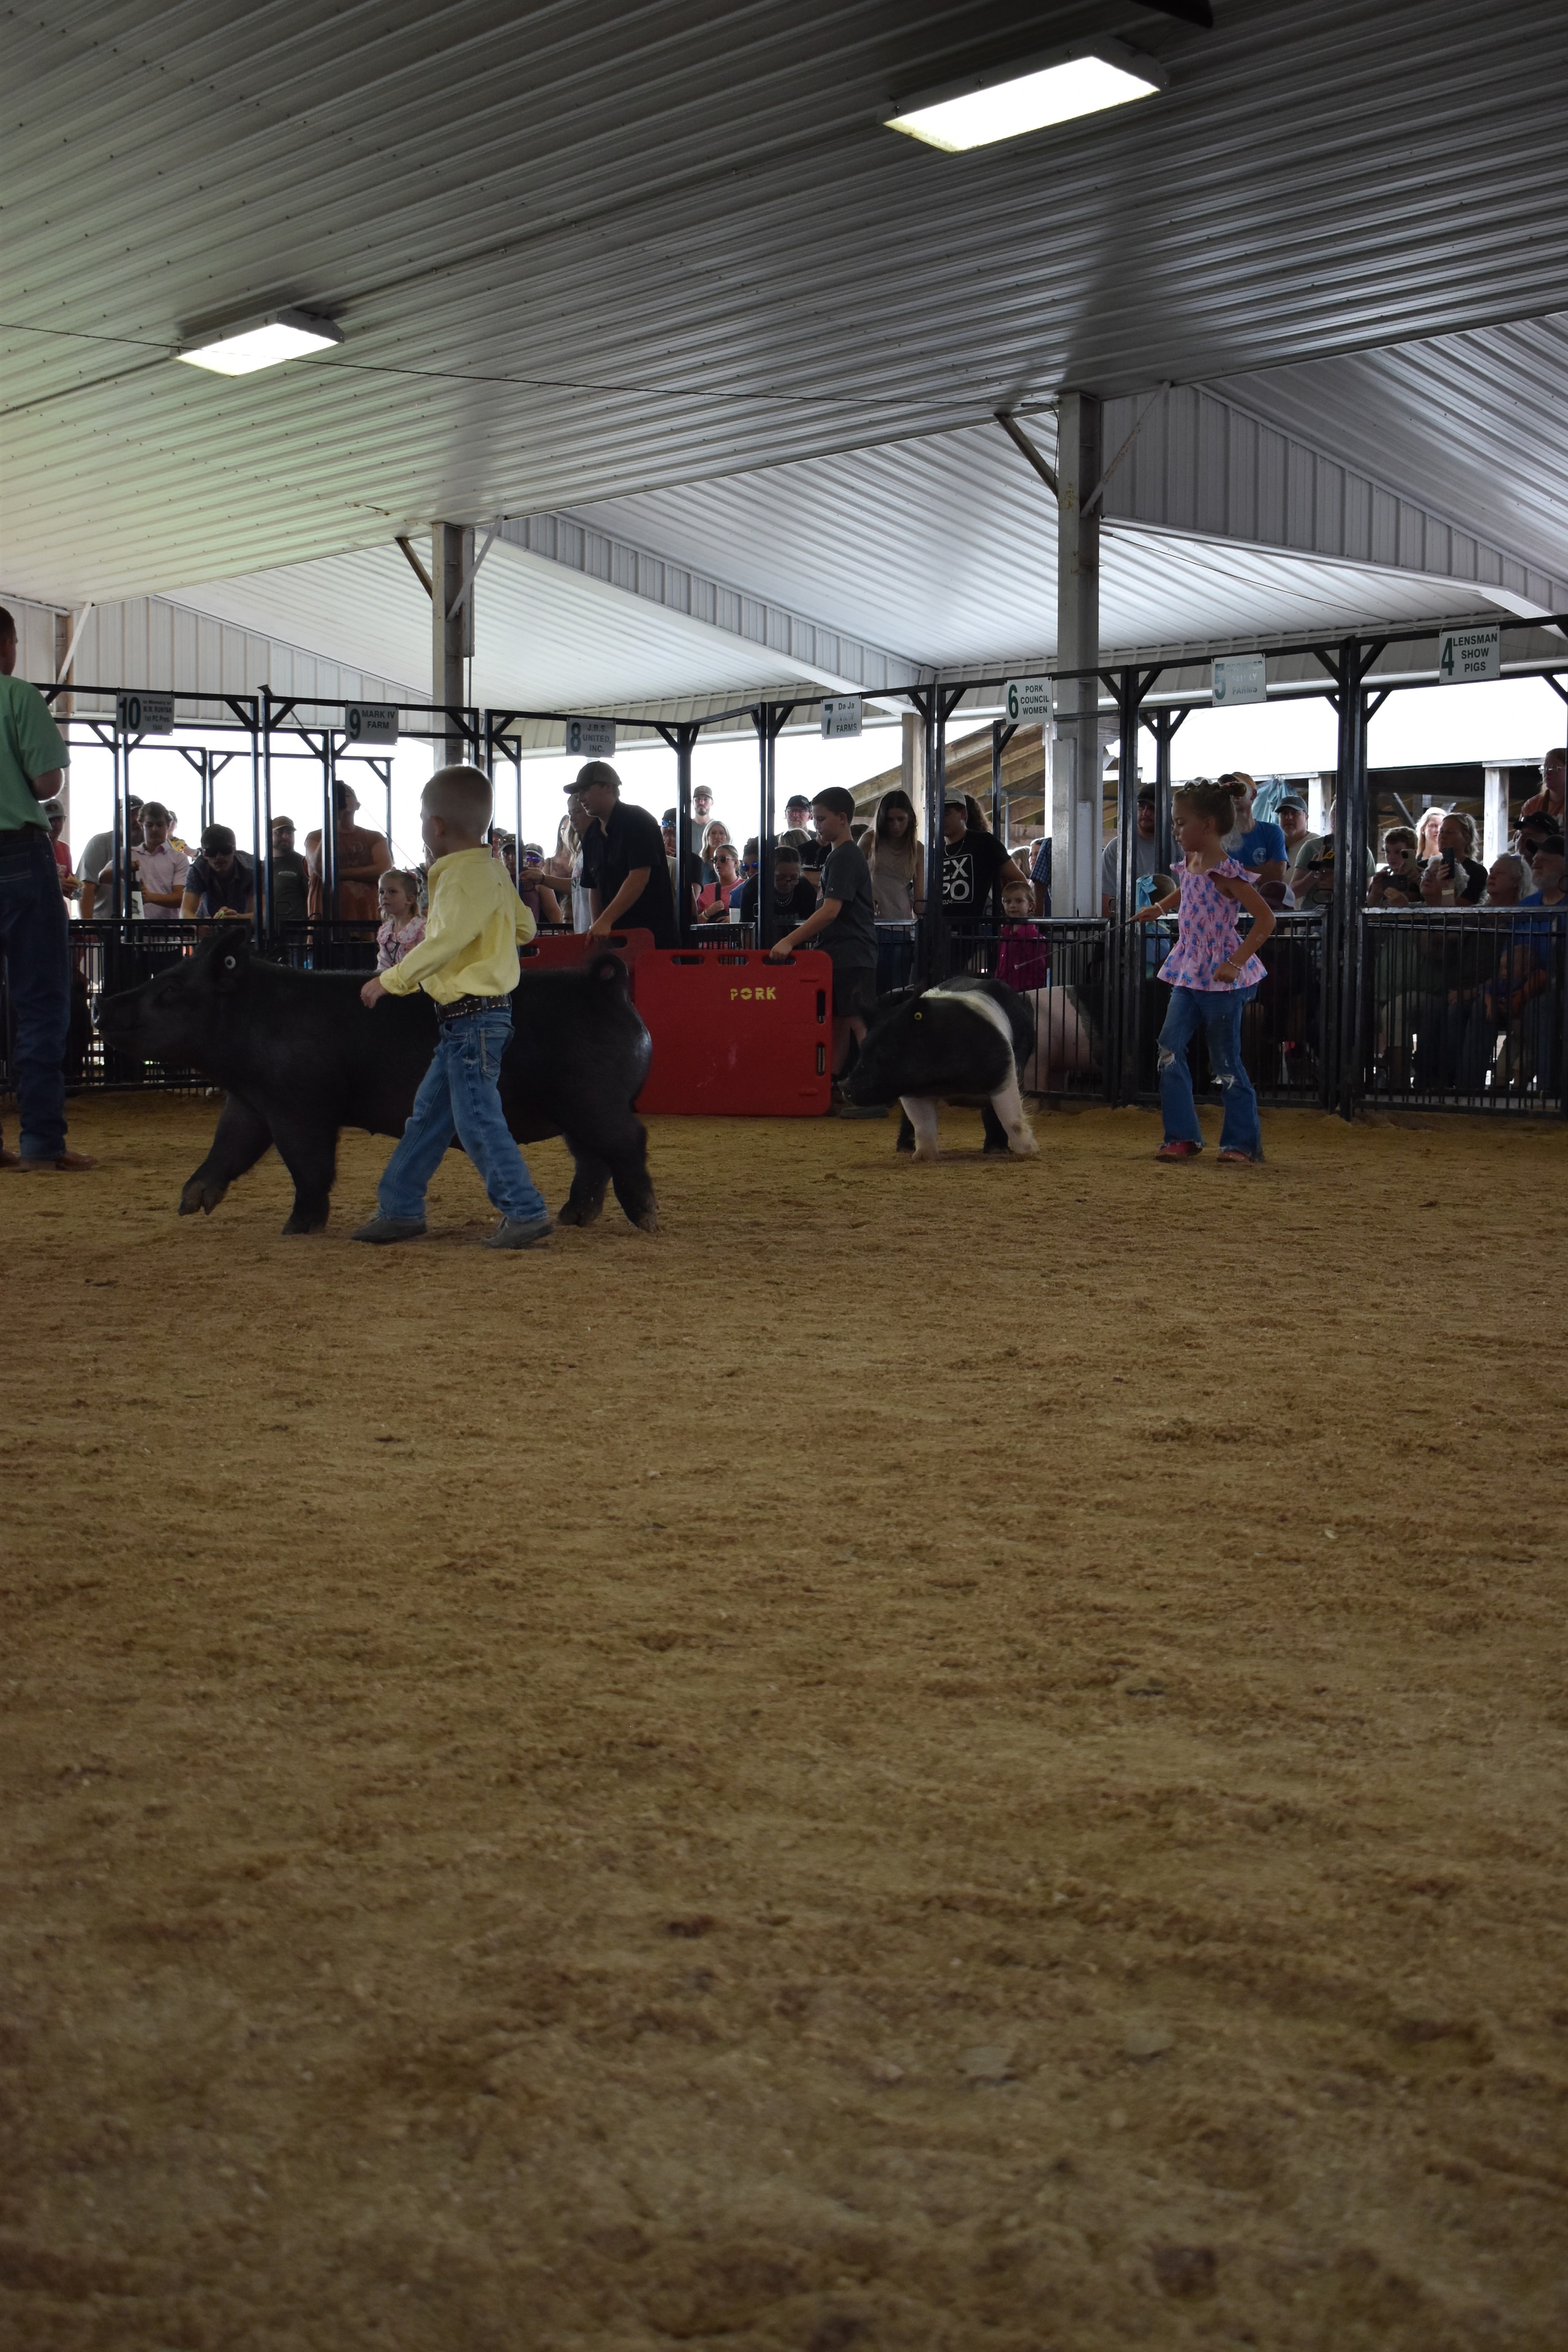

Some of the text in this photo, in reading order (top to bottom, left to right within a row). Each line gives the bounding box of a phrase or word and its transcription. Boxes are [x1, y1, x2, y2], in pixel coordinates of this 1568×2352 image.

[1453, 633, 1497, 647] LENSMAN
[1441, 638, 1454, 676] 4
[1461, 647, 1489, 659] SHOW
[1464, 662, 1486, 673] PIGS
[1215, 663, 1226, 700] 5
[1008, 684, 1019, 719] 6
[1020, 695, 1049, 704] COUNCIL
[119, 696, 141, 729] 10
[350, 709, 361, 740] 9
[824, 704, 833, 735] 7
[570, 722, 581, 752] 8
[582, 734, 611, 744] UNITED,
[837, 723, 857, 733] FARMS
[943, 856, 969, 881] EX
[730, 986, 777, 1001] PORK
